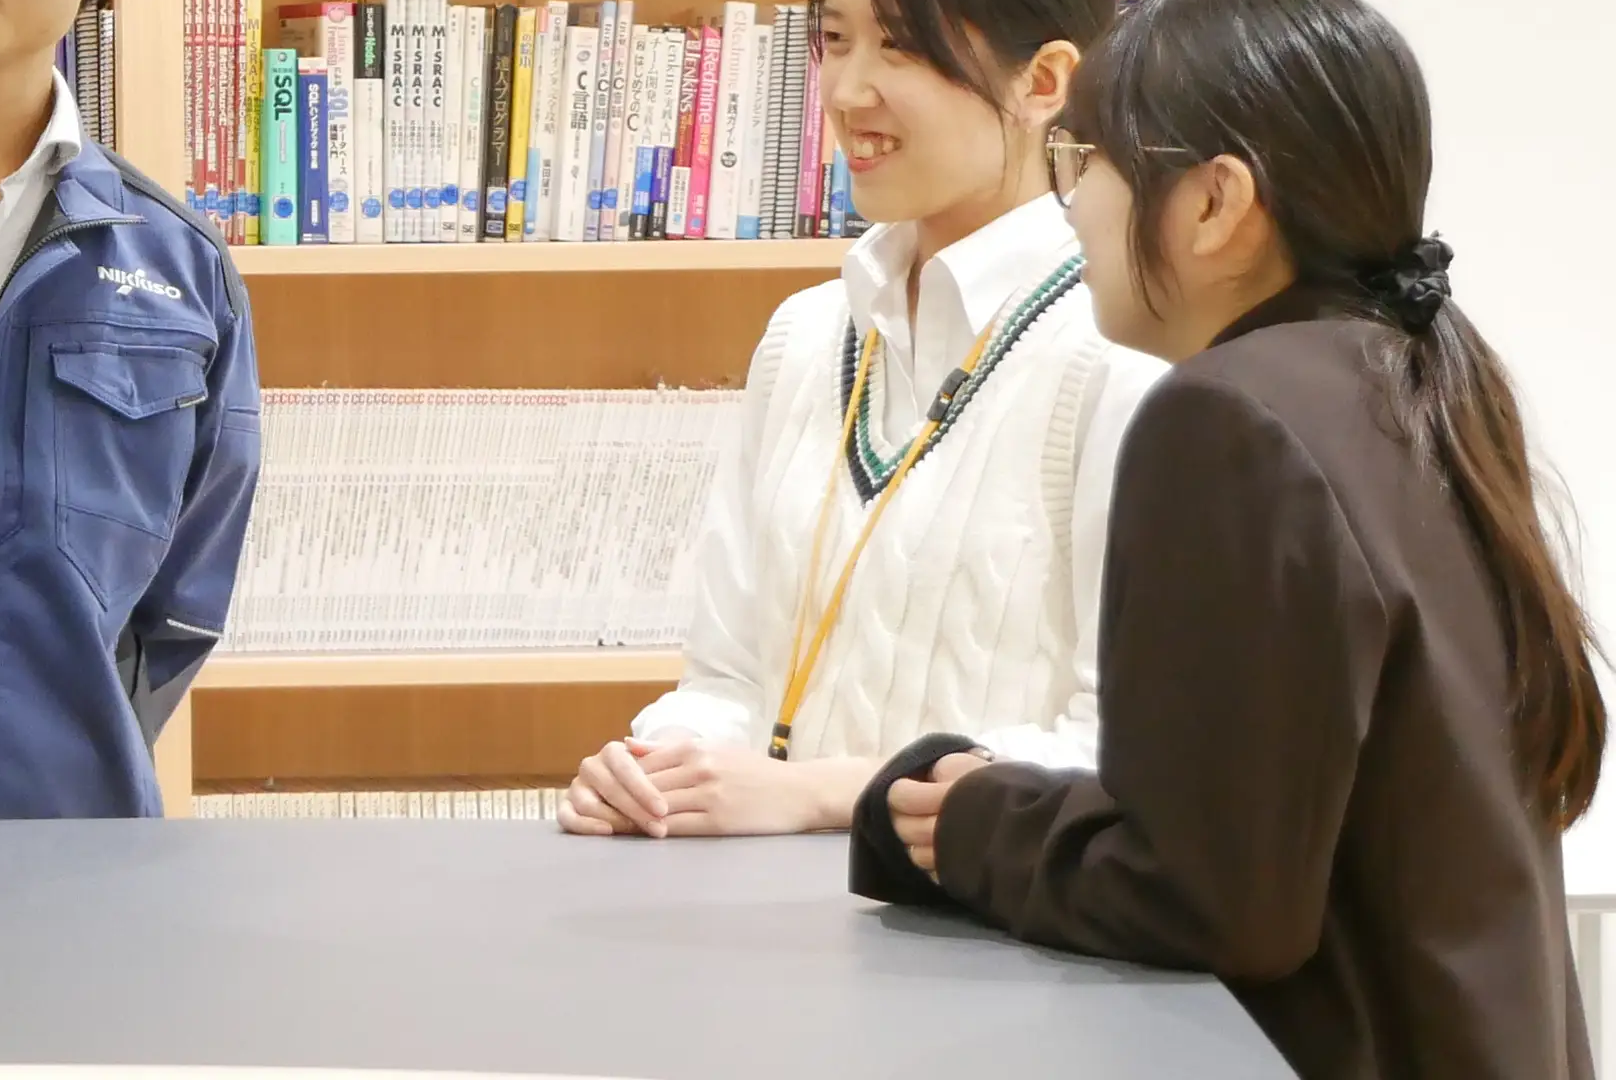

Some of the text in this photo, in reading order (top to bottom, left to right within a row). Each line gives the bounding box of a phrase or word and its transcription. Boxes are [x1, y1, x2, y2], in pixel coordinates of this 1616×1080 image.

[273, 75, 293, 121] SQL
[491, 56, 509, 167] 達人プログラマー
[570, 70, 590, 131] C言語
[699, 50, 721, 124] Redmine
[338, 123, 348, 176] データベース
